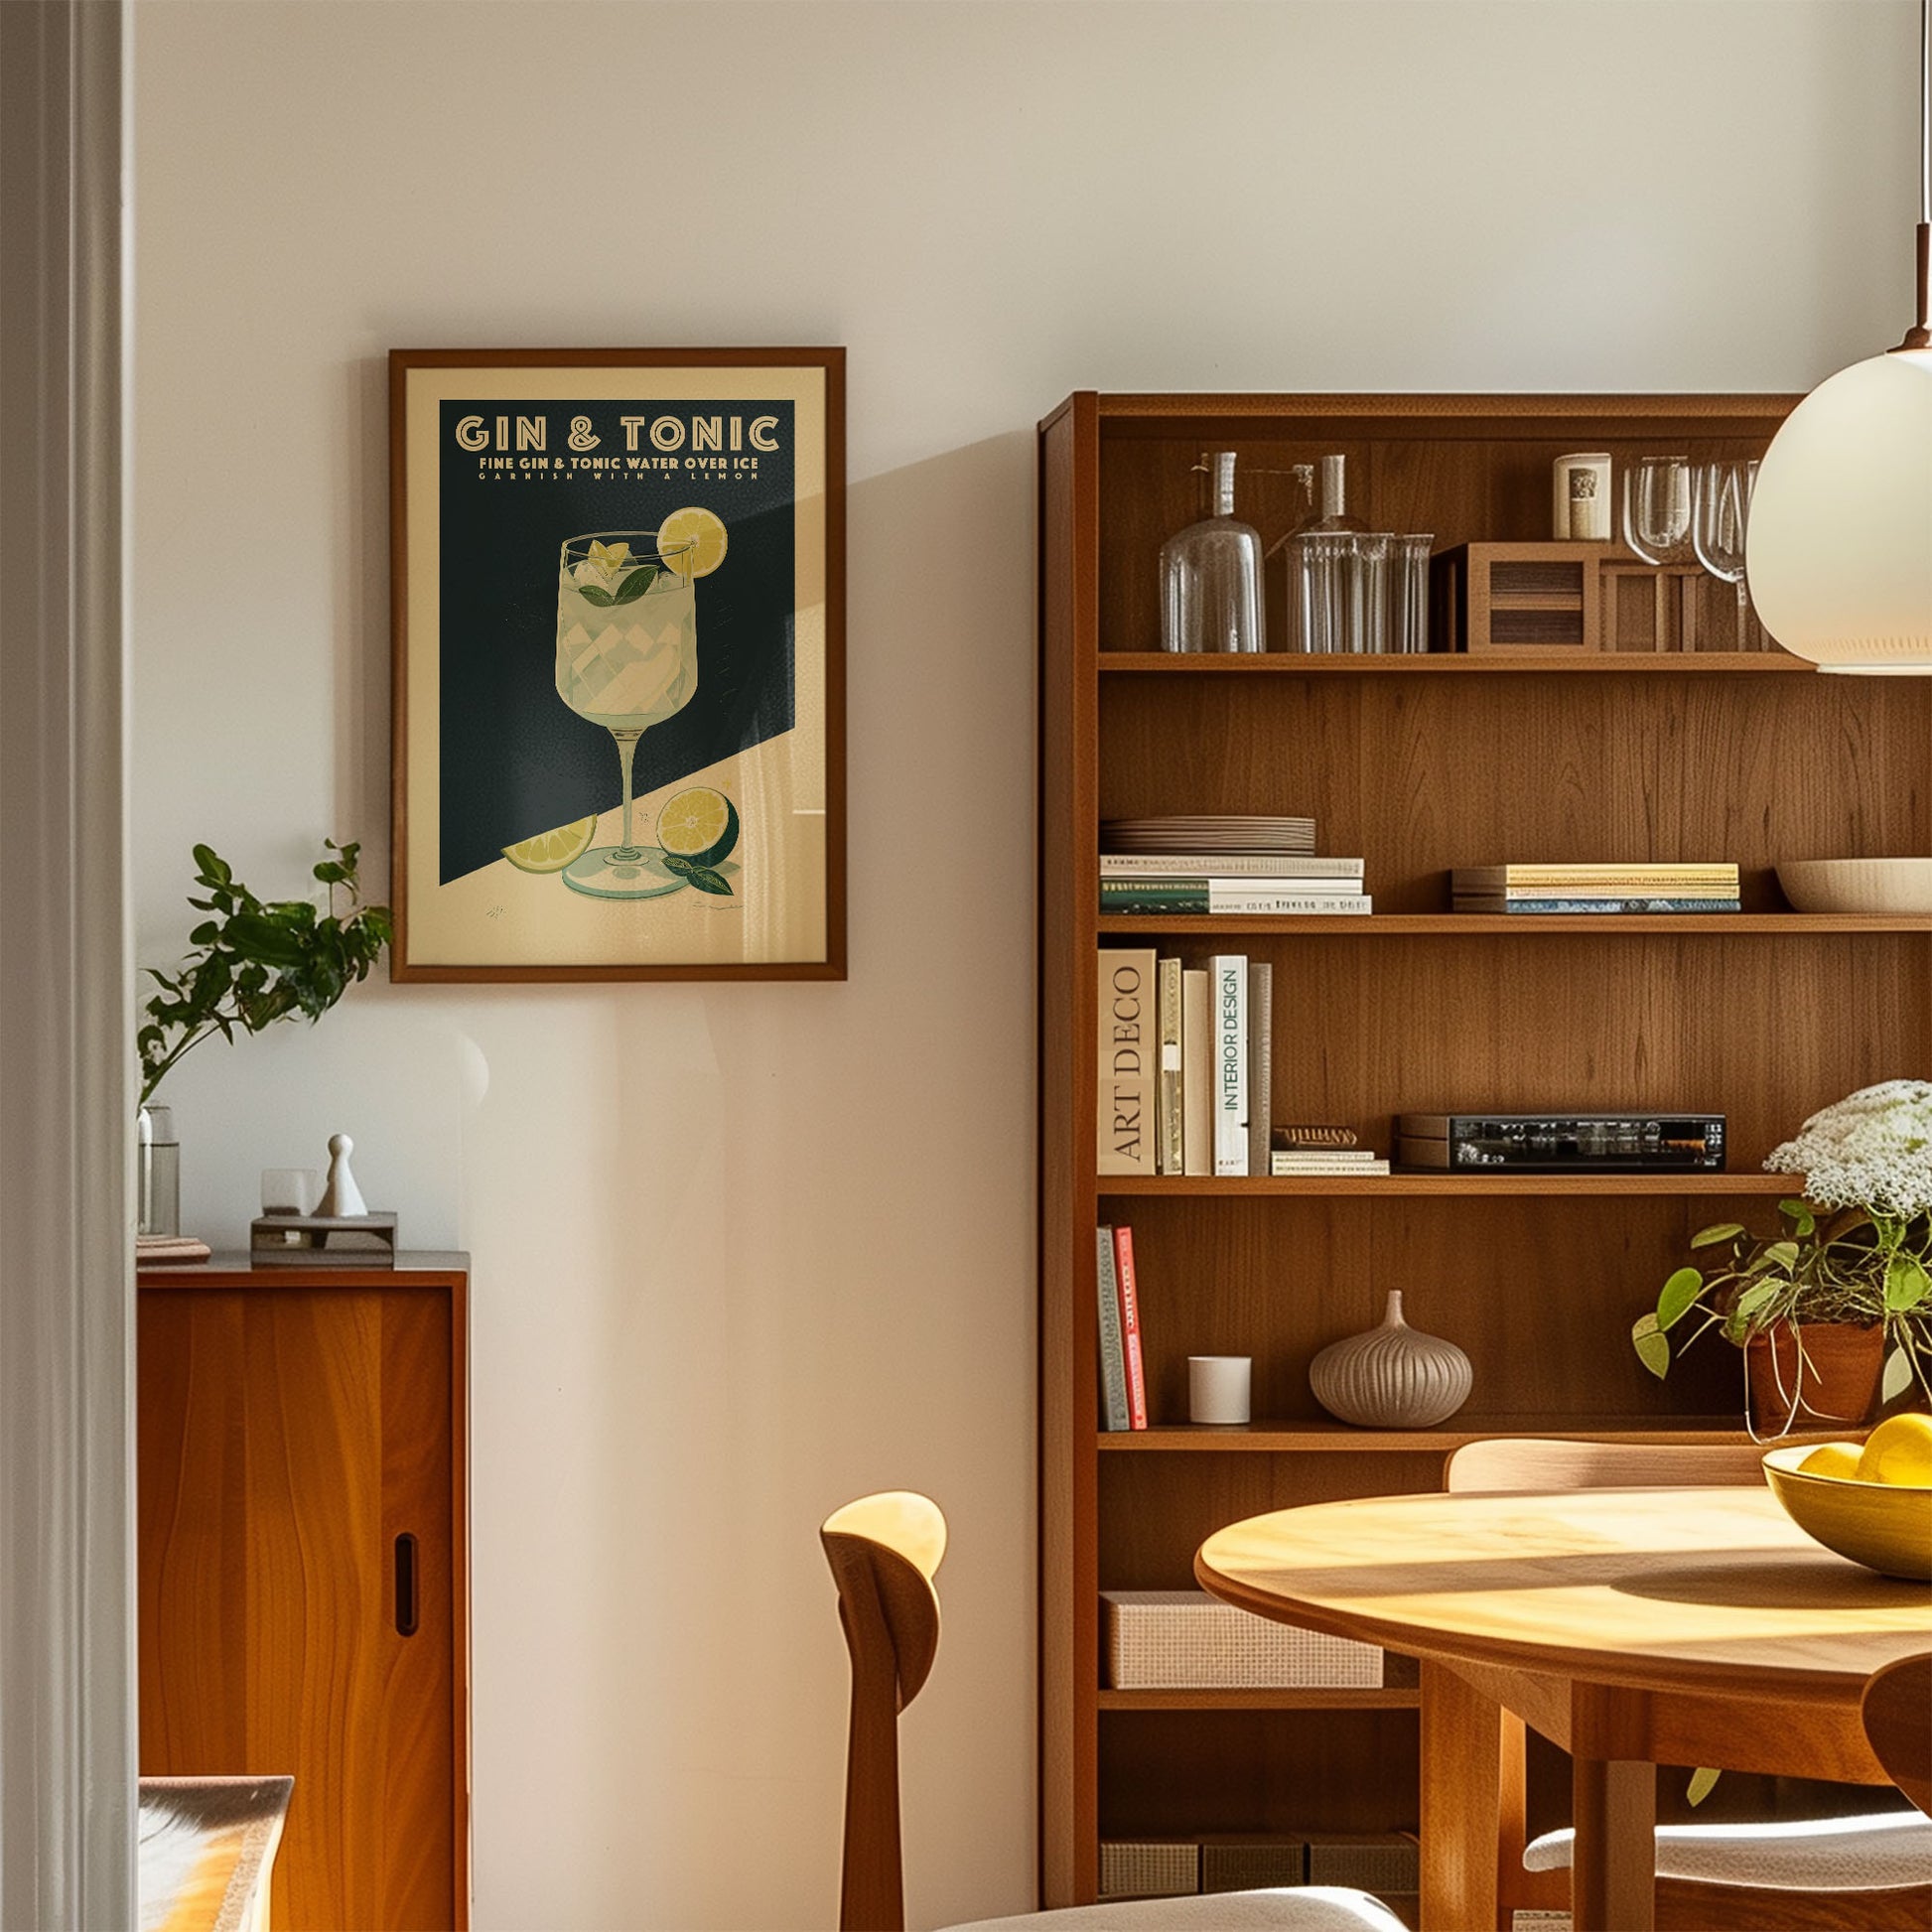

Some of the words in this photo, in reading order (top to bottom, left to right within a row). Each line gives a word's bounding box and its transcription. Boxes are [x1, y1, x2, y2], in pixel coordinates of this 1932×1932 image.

[456, 416, 546, 452] GIN
[568, 416, 602, 452] &
[620, 416, 779, 452] TONIC
[479, 458, 513, 470] FINE
[519, 458, 548, 470] GIN
[554, 458, 565, 470] &
[571, 458, 621, 470] TONIC
[626, 458, 679, 470] WATER
[684, 458, 728, 470] OVER
[734, 458, 759, 470] ICE
[1113, 966, 1141, 1076] DECO
[1223, 970, 1236, 1030] DESIGN
[1224, 1034, 1237, 1110] INTERIOR
[1114, 1085, 1140, 1163] ART
